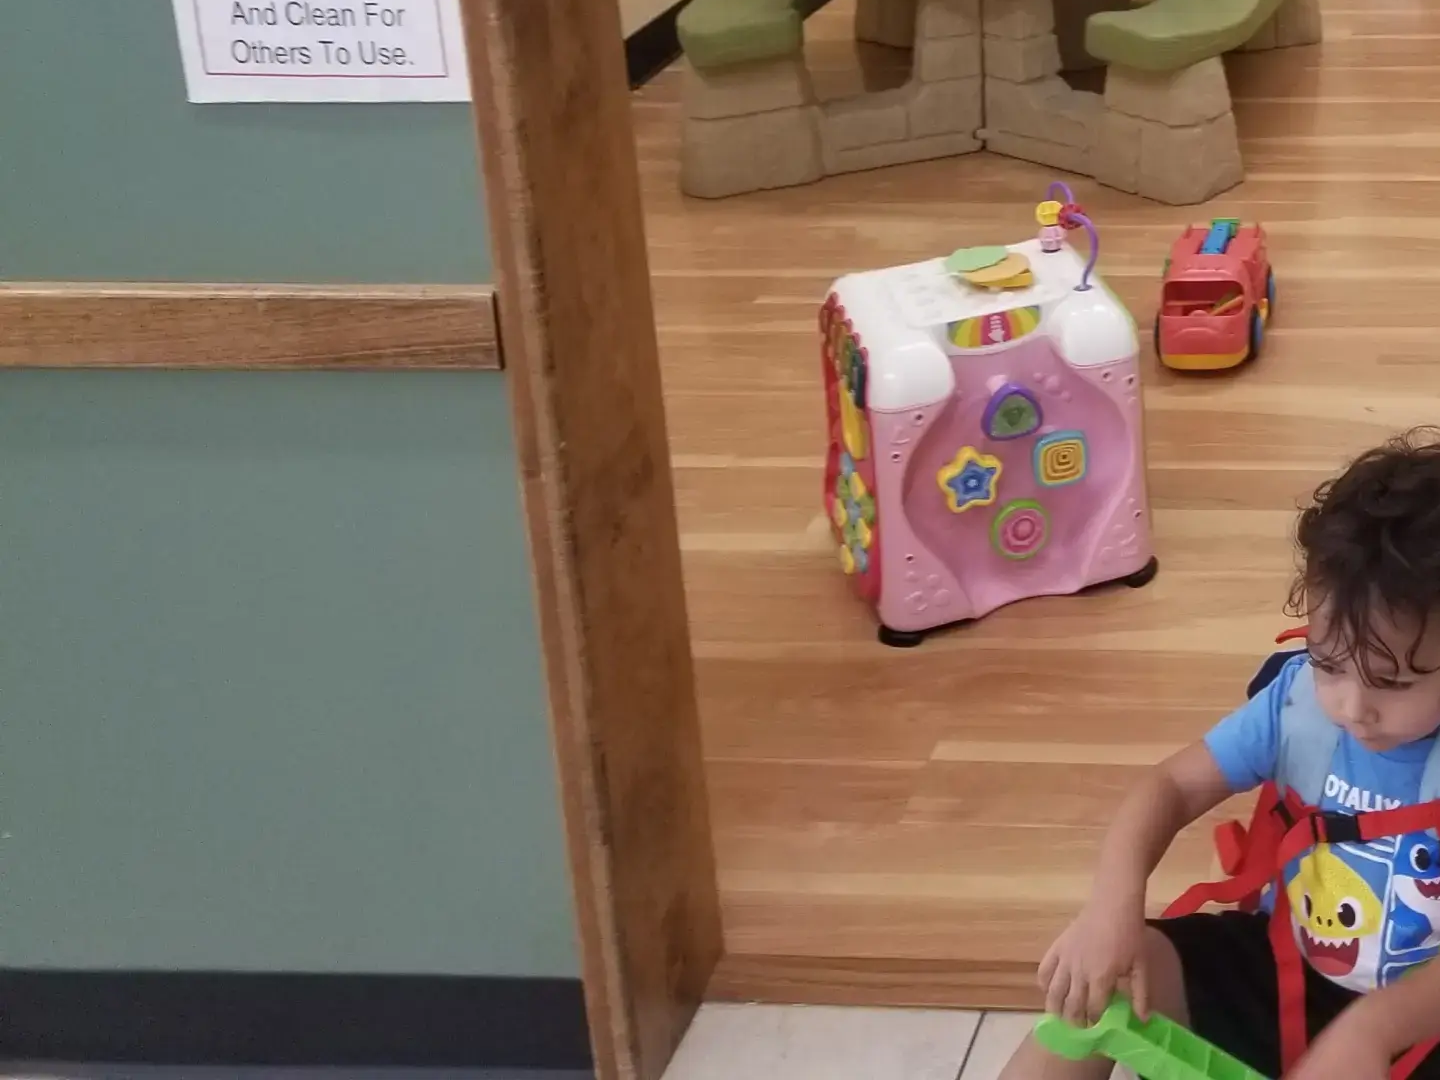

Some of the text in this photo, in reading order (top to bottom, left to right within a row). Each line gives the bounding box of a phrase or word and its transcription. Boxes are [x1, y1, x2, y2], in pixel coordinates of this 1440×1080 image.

[231, 1, 406, 27] And Clean For
[231, 39, 416, 66] Others To Use.
